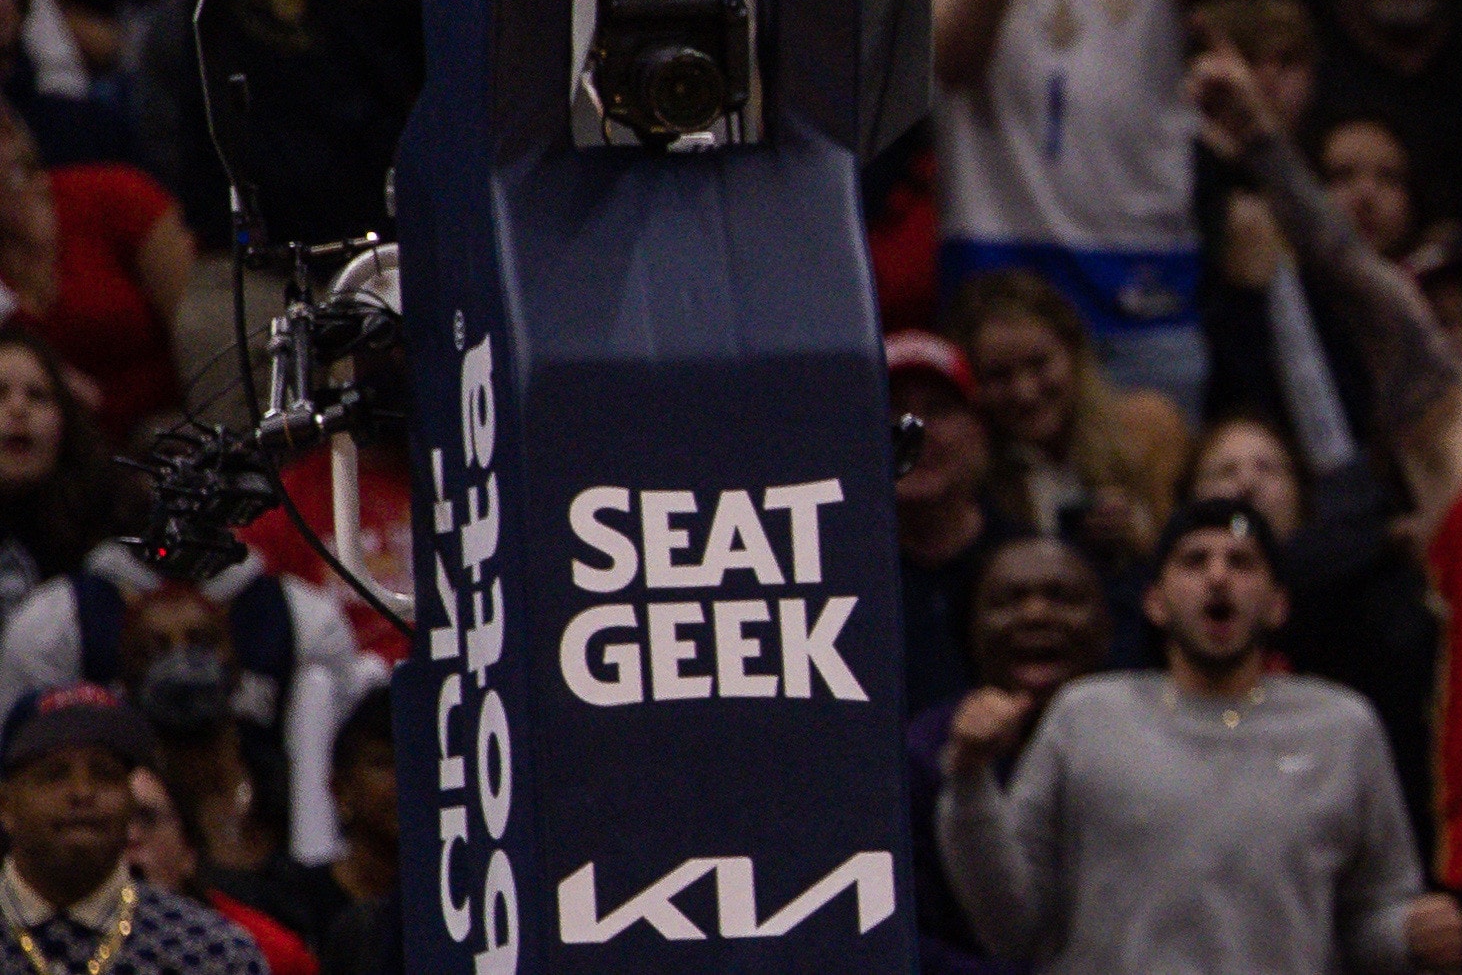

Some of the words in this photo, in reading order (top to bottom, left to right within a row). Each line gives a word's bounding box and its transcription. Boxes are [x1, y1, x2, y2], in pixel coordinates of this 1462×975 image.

[569, 478, 845, 594] SEAT
[559, 596, 871, 708] GEEK
[557, 851, 896, 944] KIA
